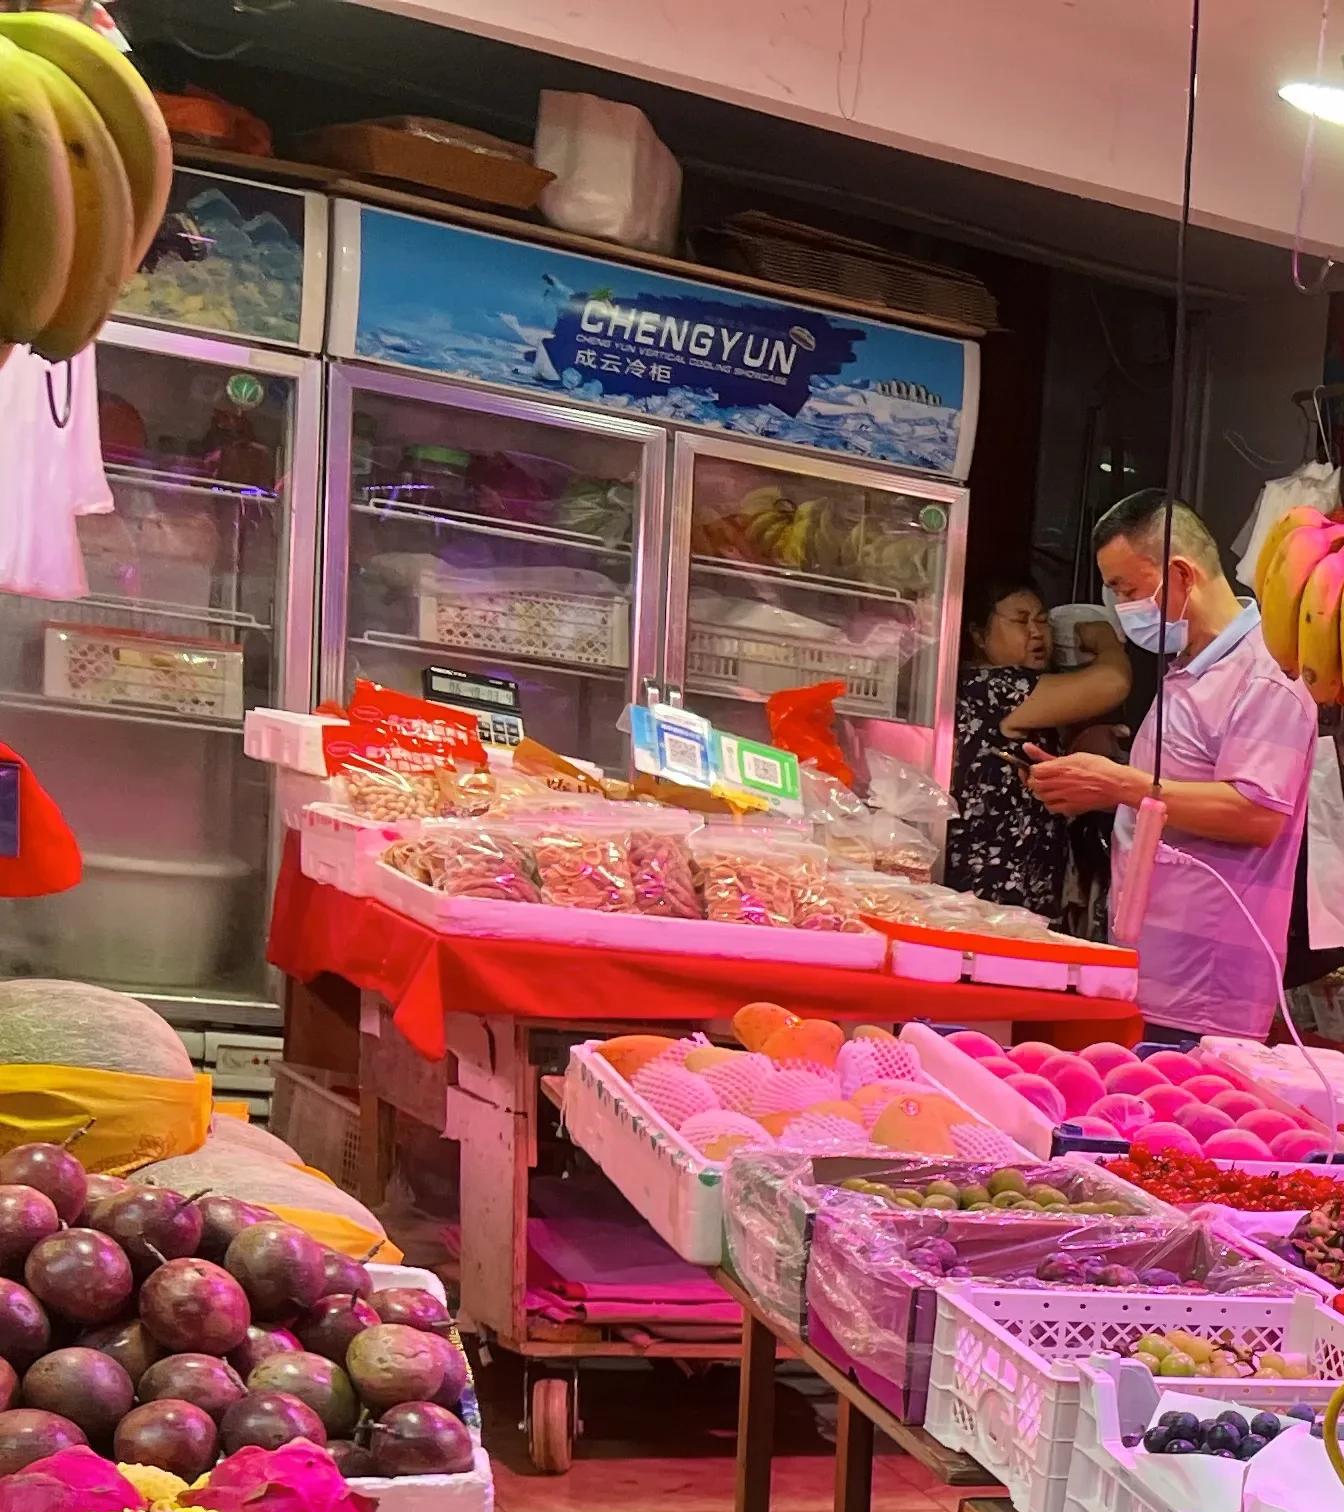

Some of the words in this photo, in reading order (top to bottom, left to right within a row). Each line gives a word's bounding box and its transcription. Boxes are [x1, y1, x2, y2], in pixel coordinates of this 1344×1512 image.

[579, 299, 797, 375] CHENGYUN
[574, 349, 673, 384] 成云冷柜
[638, 347, 687, 365] VERTICAL
